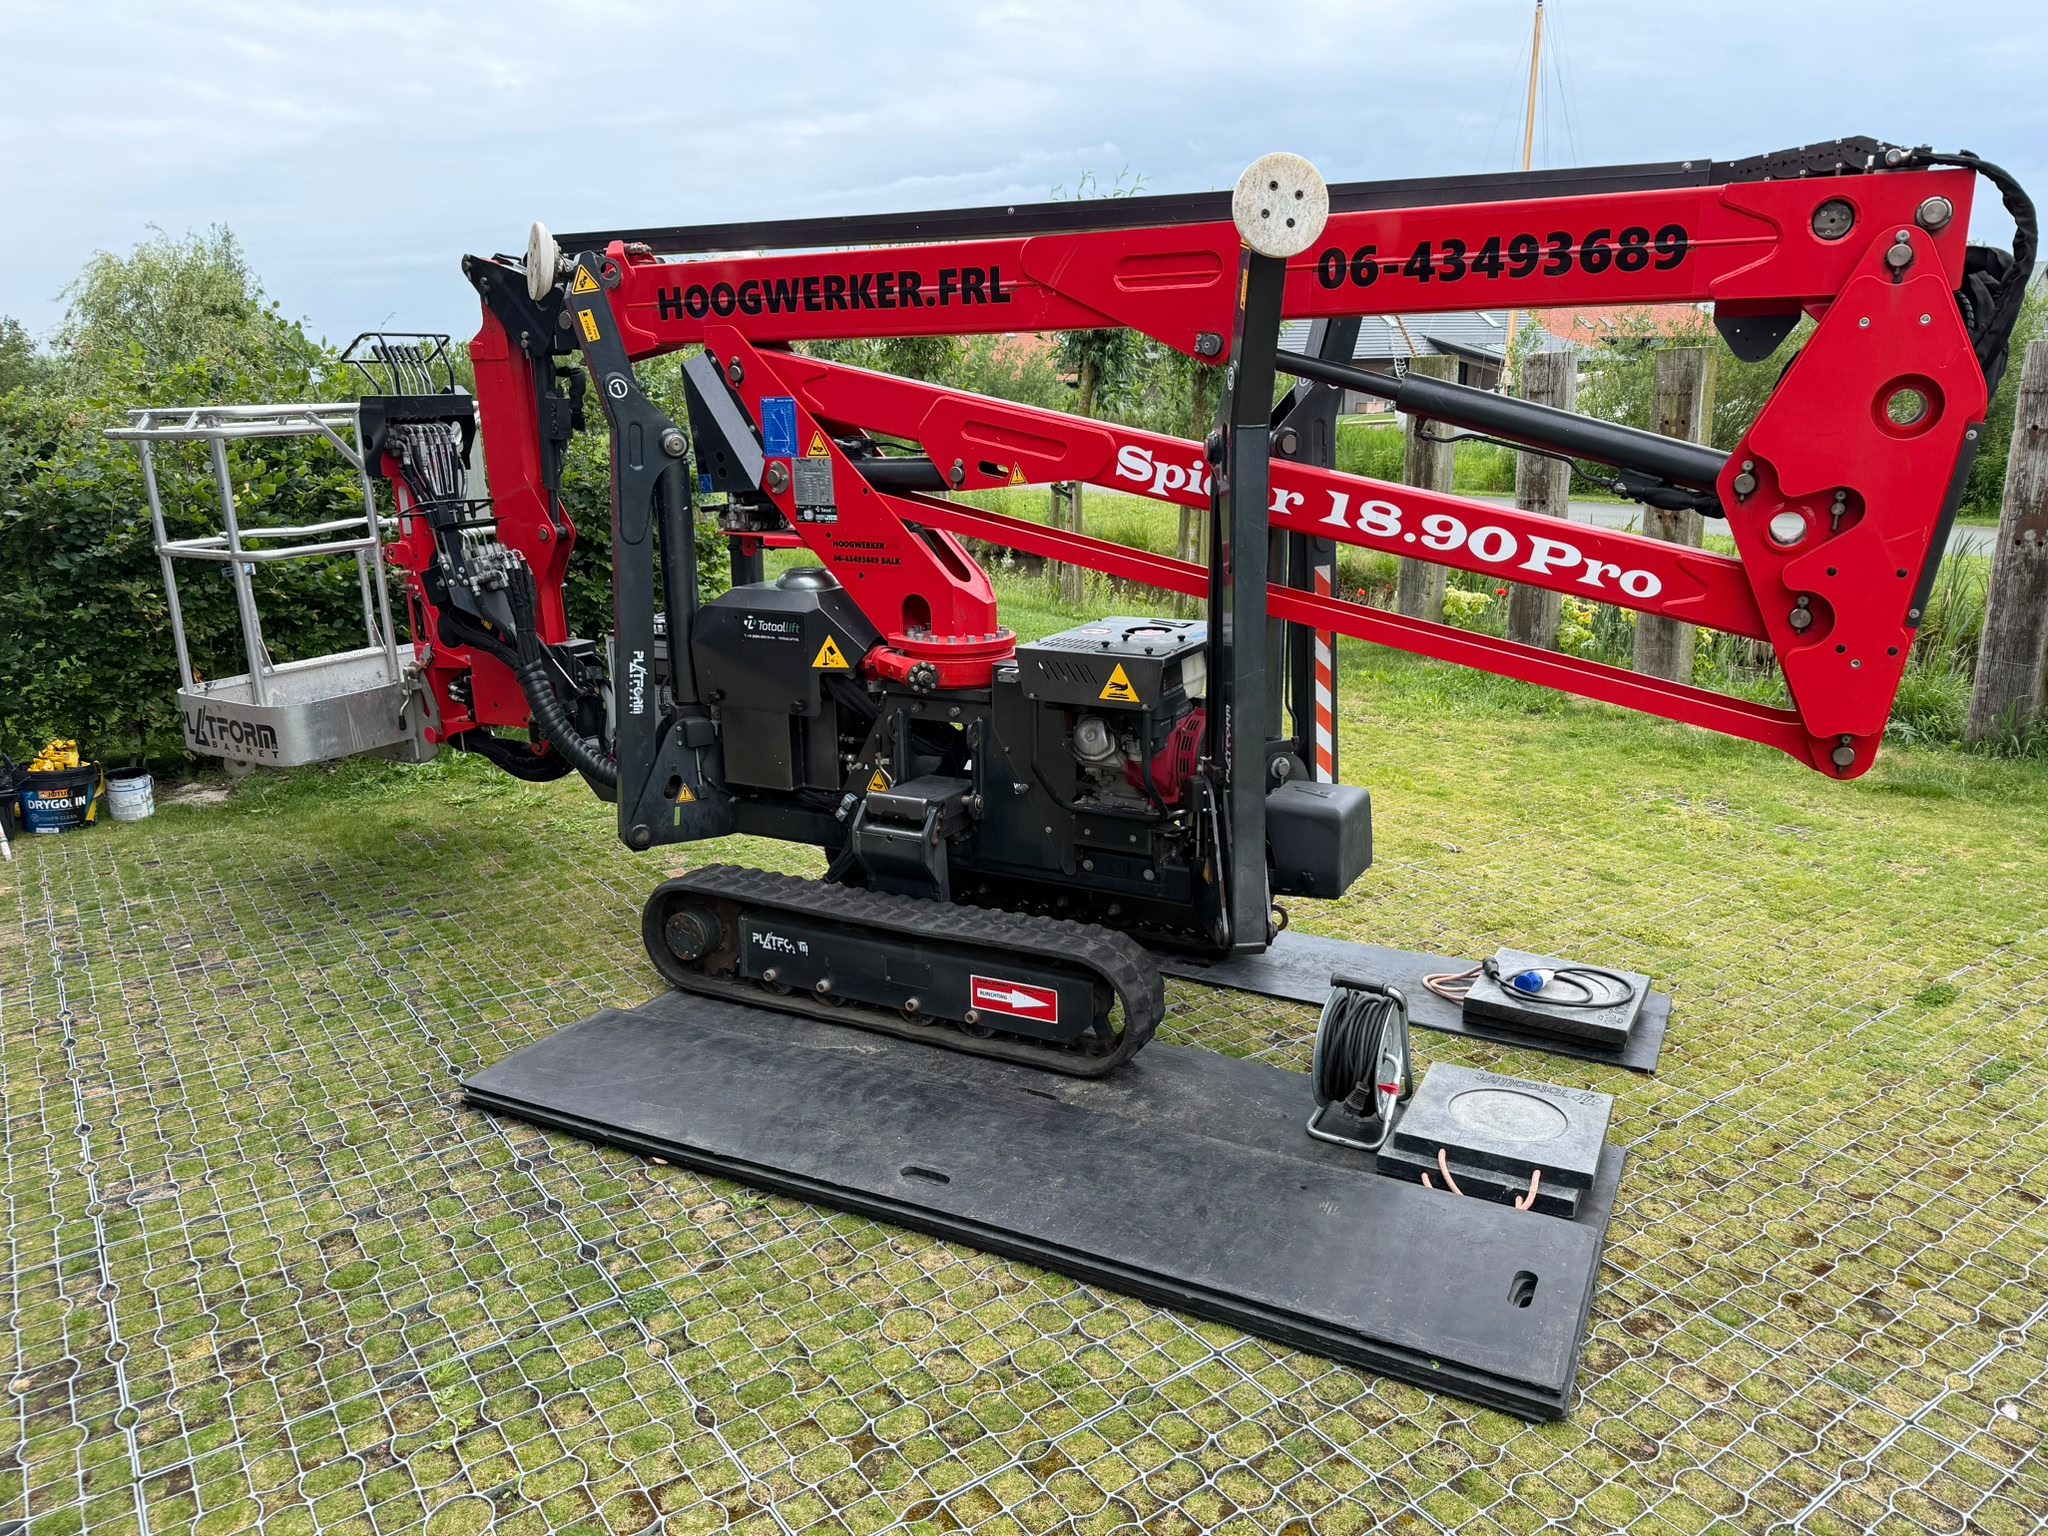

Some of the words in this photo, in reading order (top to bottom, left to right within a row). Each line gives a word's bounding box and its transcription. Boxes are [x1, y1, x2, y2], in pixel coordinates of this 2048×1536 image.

[1317, 223, 1689, 290] 06-43493689
[657, 265, 1012, 322] HOOGWERKER.FRL
[1115, 445, 1305, 516] Spir
[881, 557, 901, 566] BALK
[758, 619, 801, 634] Totaallift
[211, 740, 279, 759] BASKET
[27, 795, 87, 810] DRYGOLIN
[60, 813, 78, 821] CLEAN
